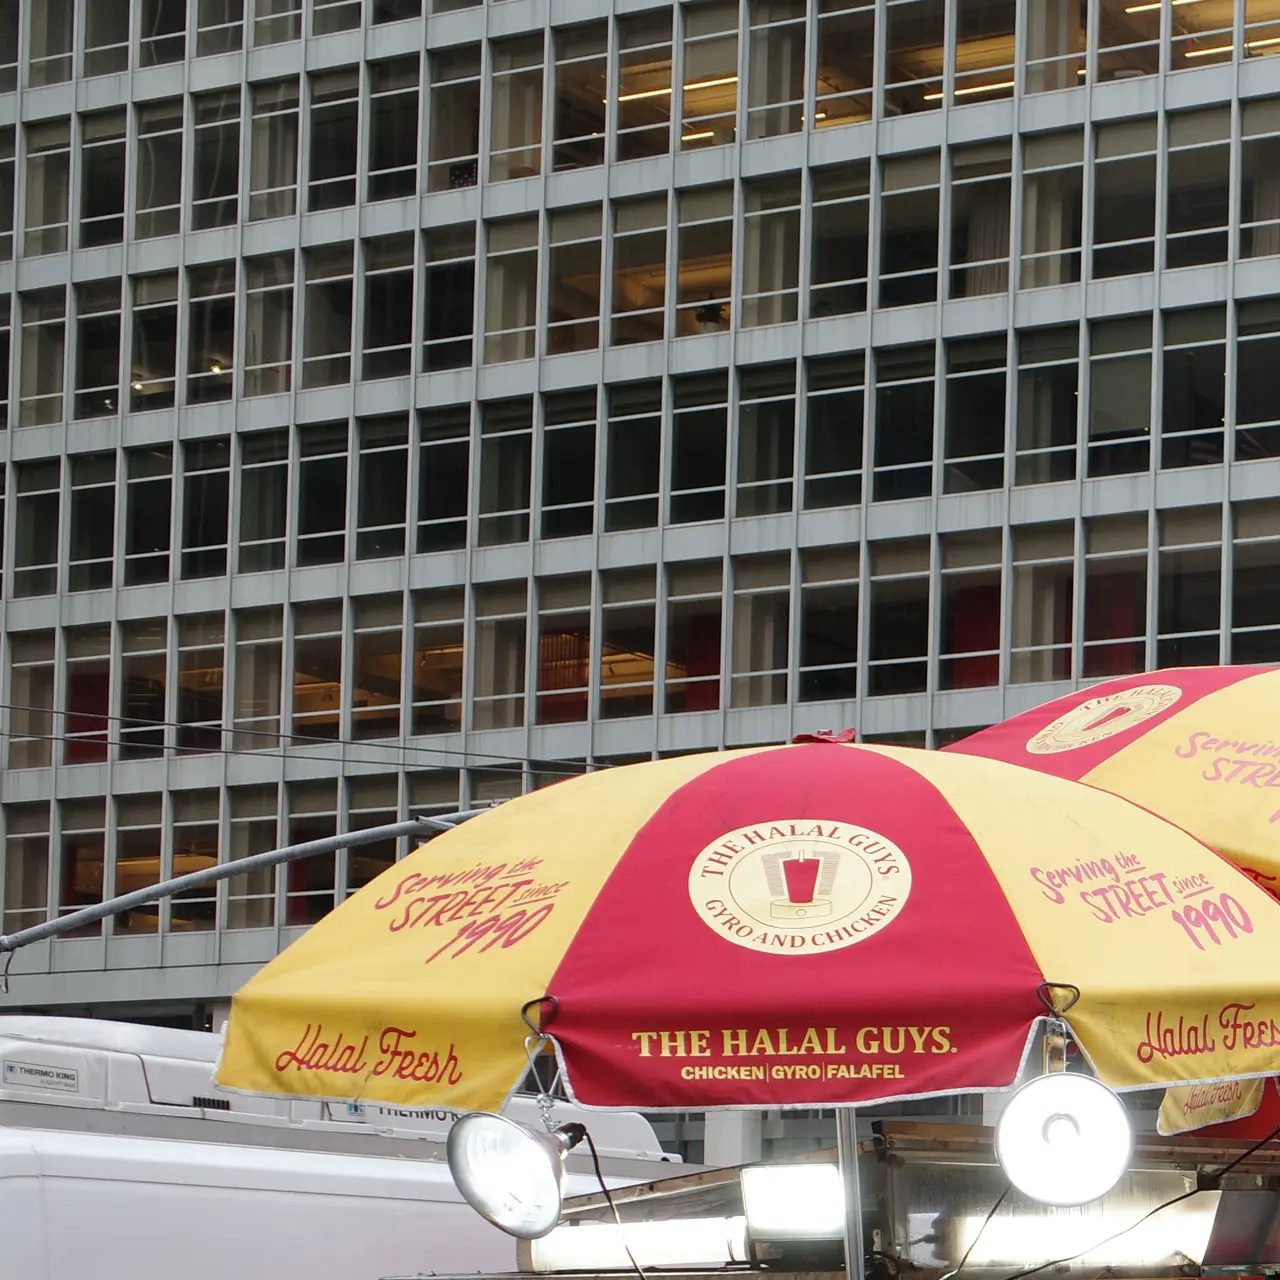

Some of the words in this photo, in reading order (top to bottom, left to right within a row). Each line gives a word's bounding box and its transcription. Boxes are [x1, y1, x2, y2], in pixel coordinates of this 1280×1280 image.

[701, 840, 746, 878] THE
[742, 823, 843, 846] HALAL
[374, 862, 507, 910] Serving
[503, 855, 545, 877] the
[1030, 856, 1118, 904] Serving
[1114, 851, 1146, 873] the
[1078, 873, 1174, 924] STREET
[1173, 869, 1213, 901] since
[389, 880, 529, 932] STREET
[518, 880, 571, 900] since
[705, 898, 754, 939] GYRO
[752, 931, 806, 949] AND
[811, 894, 898, 947] CHICKEN
[1171, 893, 1255, 950] 1990
[425, 903, 554, 965] 1990
[275, 1024, 368, 1074] Halal
[631, 1029, 711, 1058] THE
[721, 1027, 846, 1057] HALAL
[1136, 1011, 1214, 1064] Halal
[19, 1066, 55, 1078] THERMO
[55, 1072, 77, 1082] KING
[681, 1064, 764, 1081] CHICKEN
[769, 1064, 821, 1081] GYRO
[827, 1064, 905, 1080] FALAFEL
